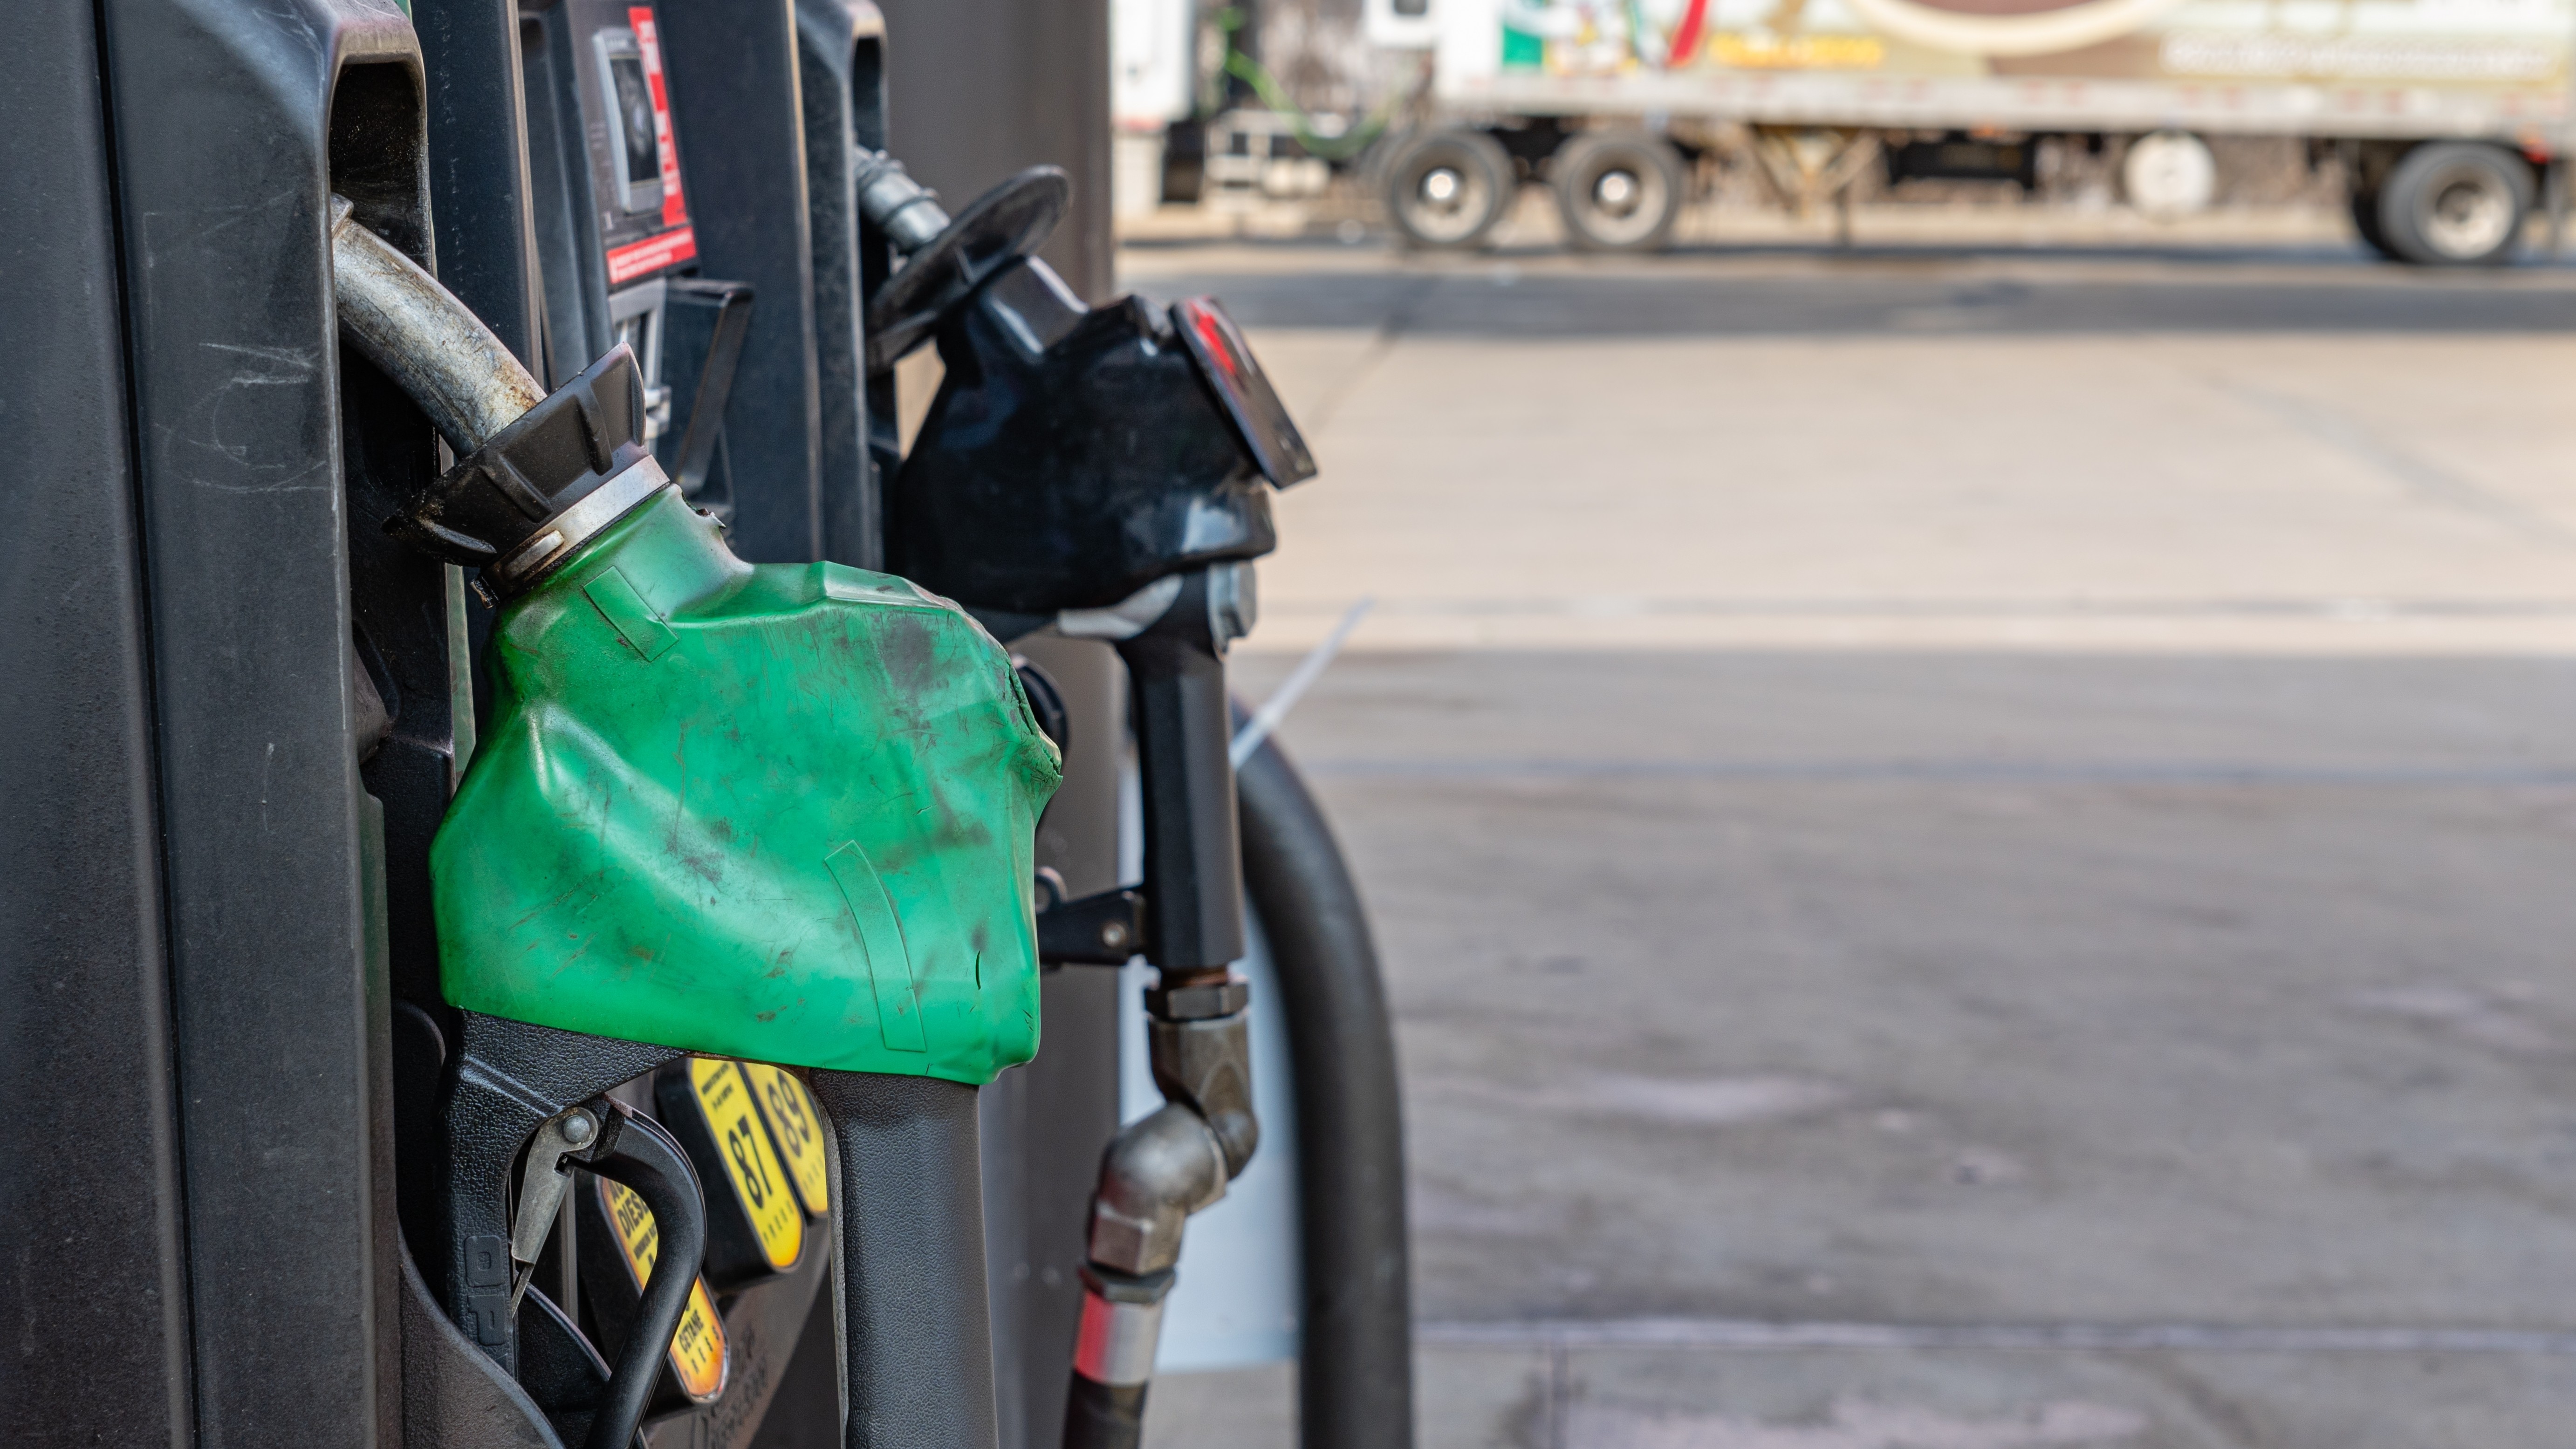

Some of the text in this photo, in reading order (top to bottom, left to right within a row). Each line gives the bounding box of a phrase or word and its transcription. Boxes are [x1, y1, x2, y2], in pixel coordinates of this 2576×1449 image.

[767, 1069, 810, 1158] 89
[728, 1113, 773, 1210] 87
[678, 1308, 705, 1353] CETANE
